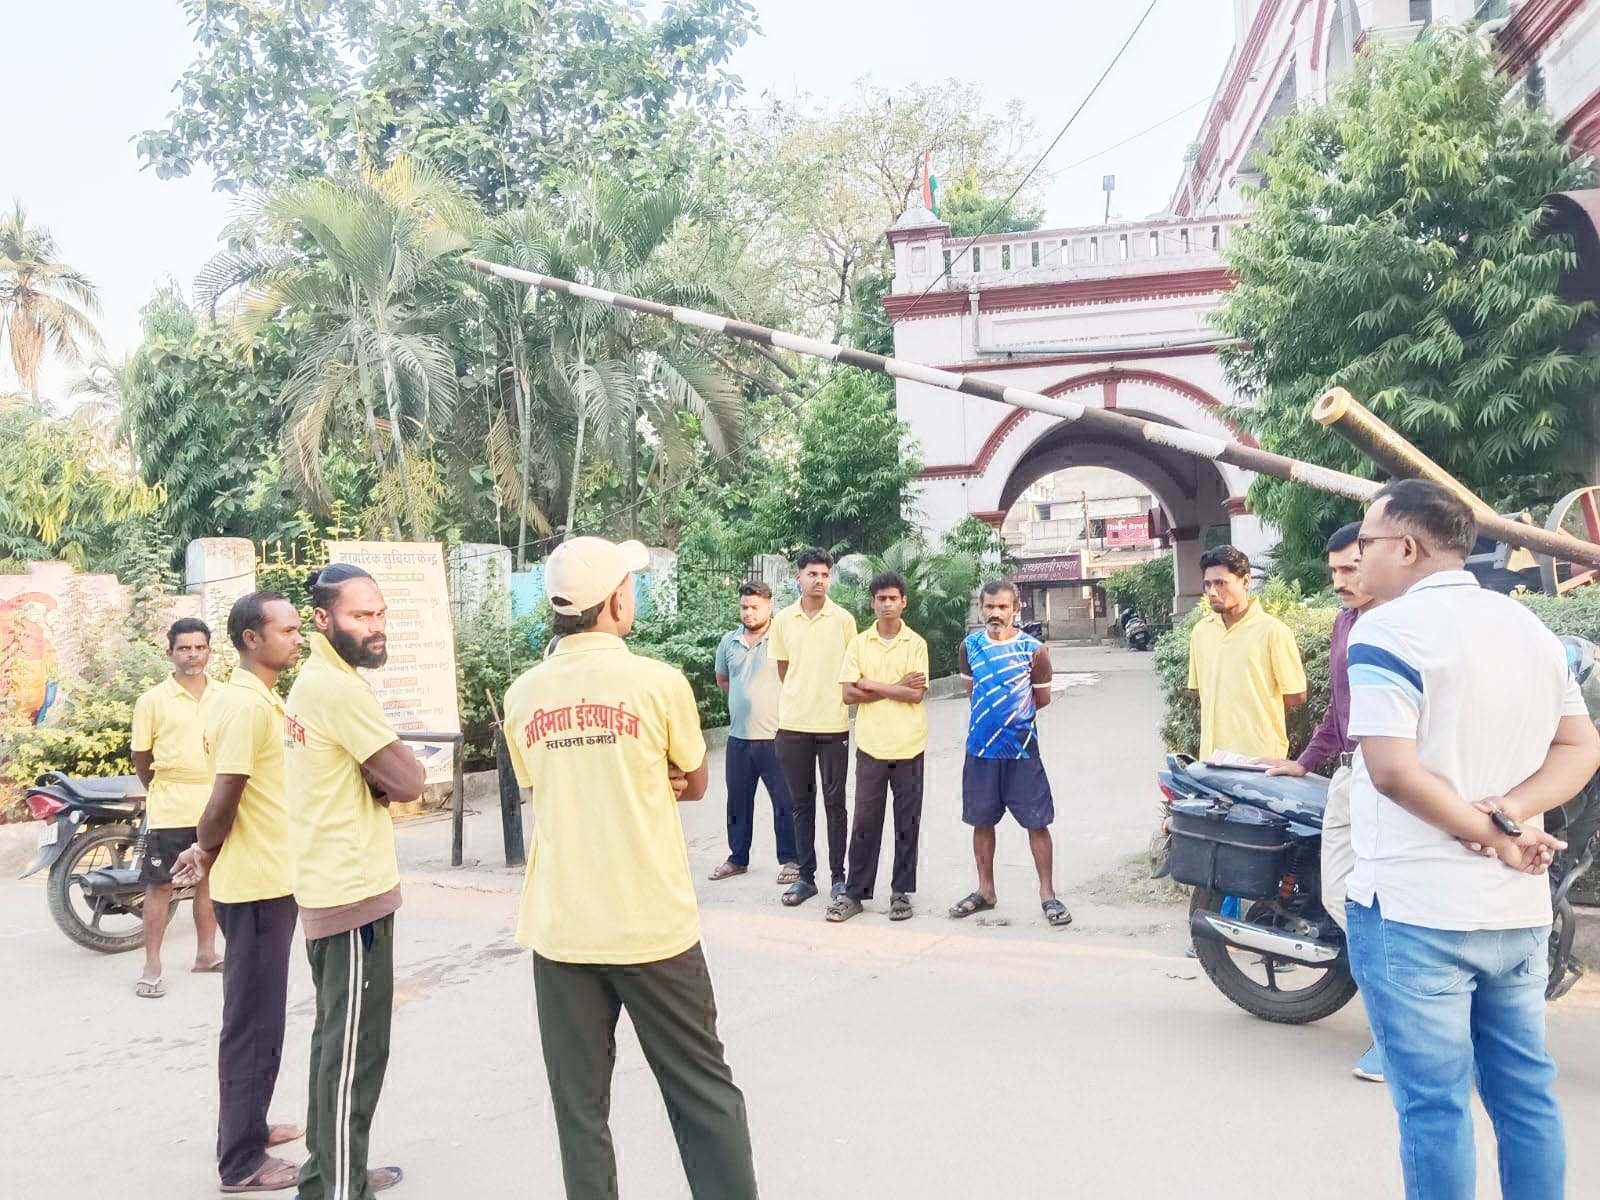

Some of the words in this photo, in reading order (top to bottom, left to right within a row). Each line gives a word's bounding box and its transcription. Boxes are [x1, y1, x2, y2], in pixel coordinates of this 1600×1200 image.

[338, 548, 381, 565] नागरिक
[382, 548, 415, 569] सुविधा
[524, 707, 572, 749] अस्मिता
[575, 698, 640, 739] इंटरप्राईज
[545, 736, 584, 750] स्वच्छता
